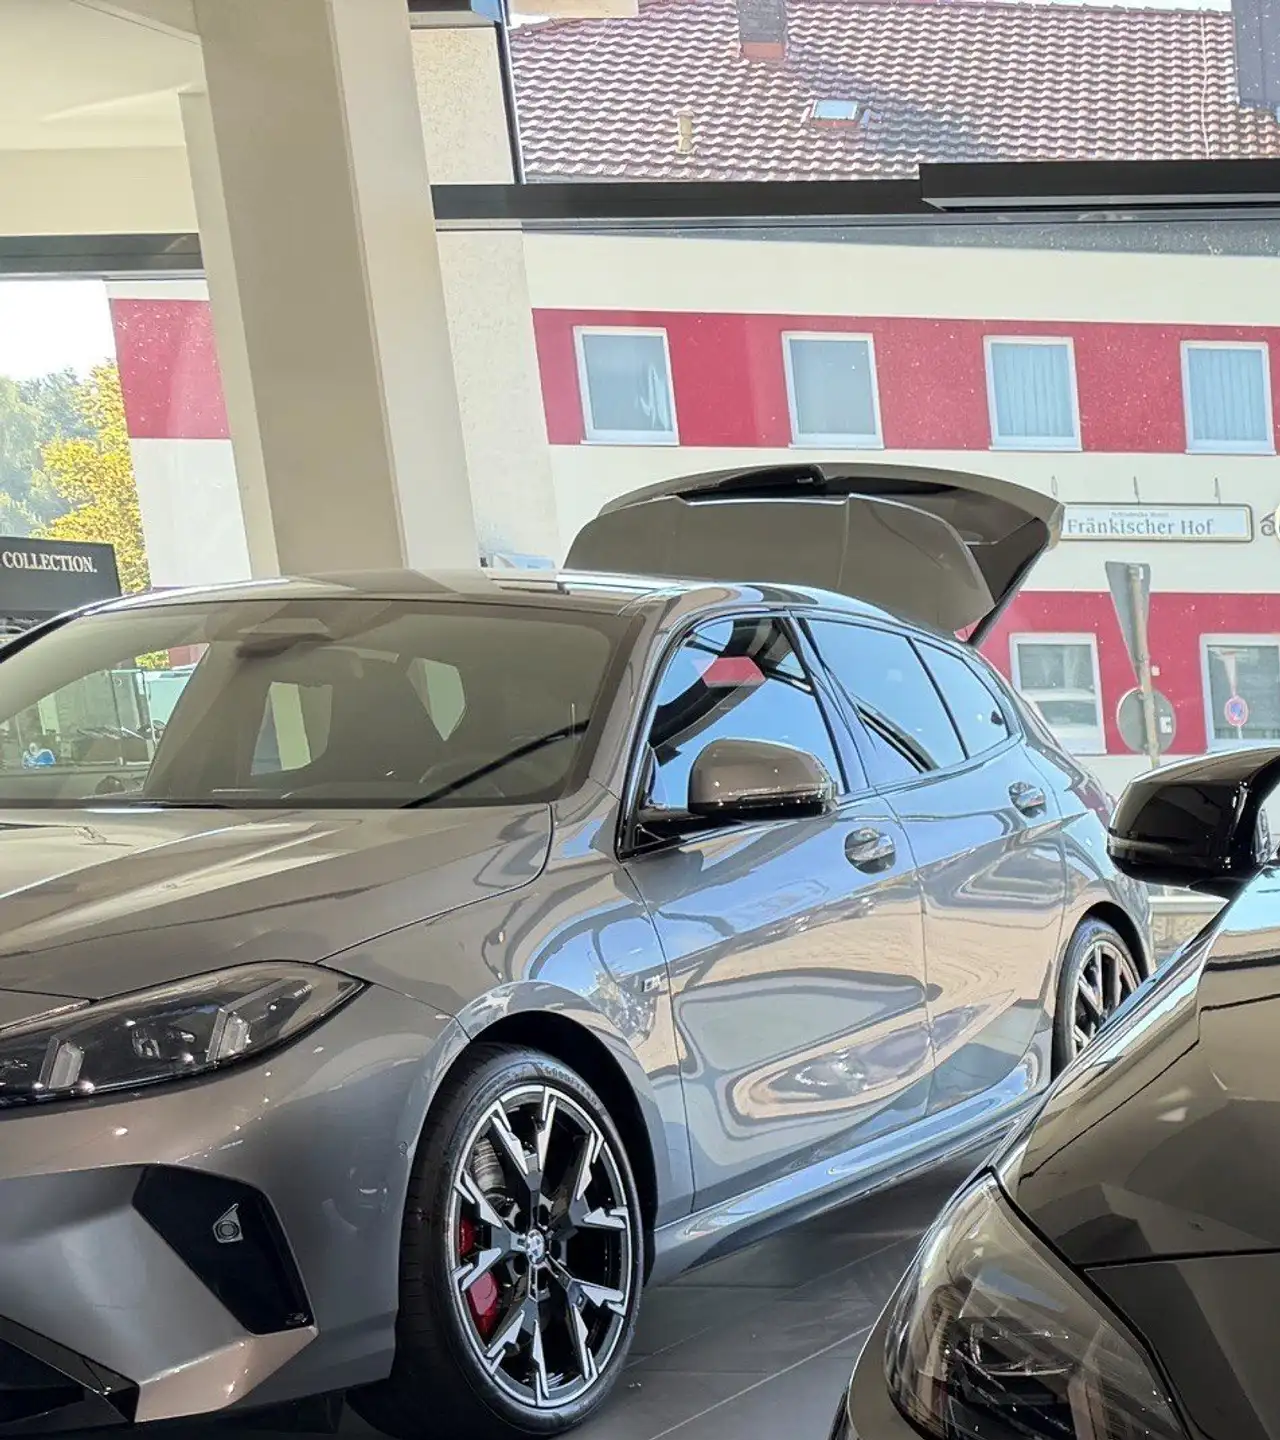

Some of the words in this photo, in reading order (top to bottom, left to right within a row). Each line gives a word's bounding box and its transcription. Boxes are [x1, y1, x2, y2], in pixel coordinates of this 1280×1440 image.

[1067, 517, 1175, 535] Fränkischer
[1181, 517, 1214, 535] Hof
[2, 551, 98, 573] COLLECTION.
